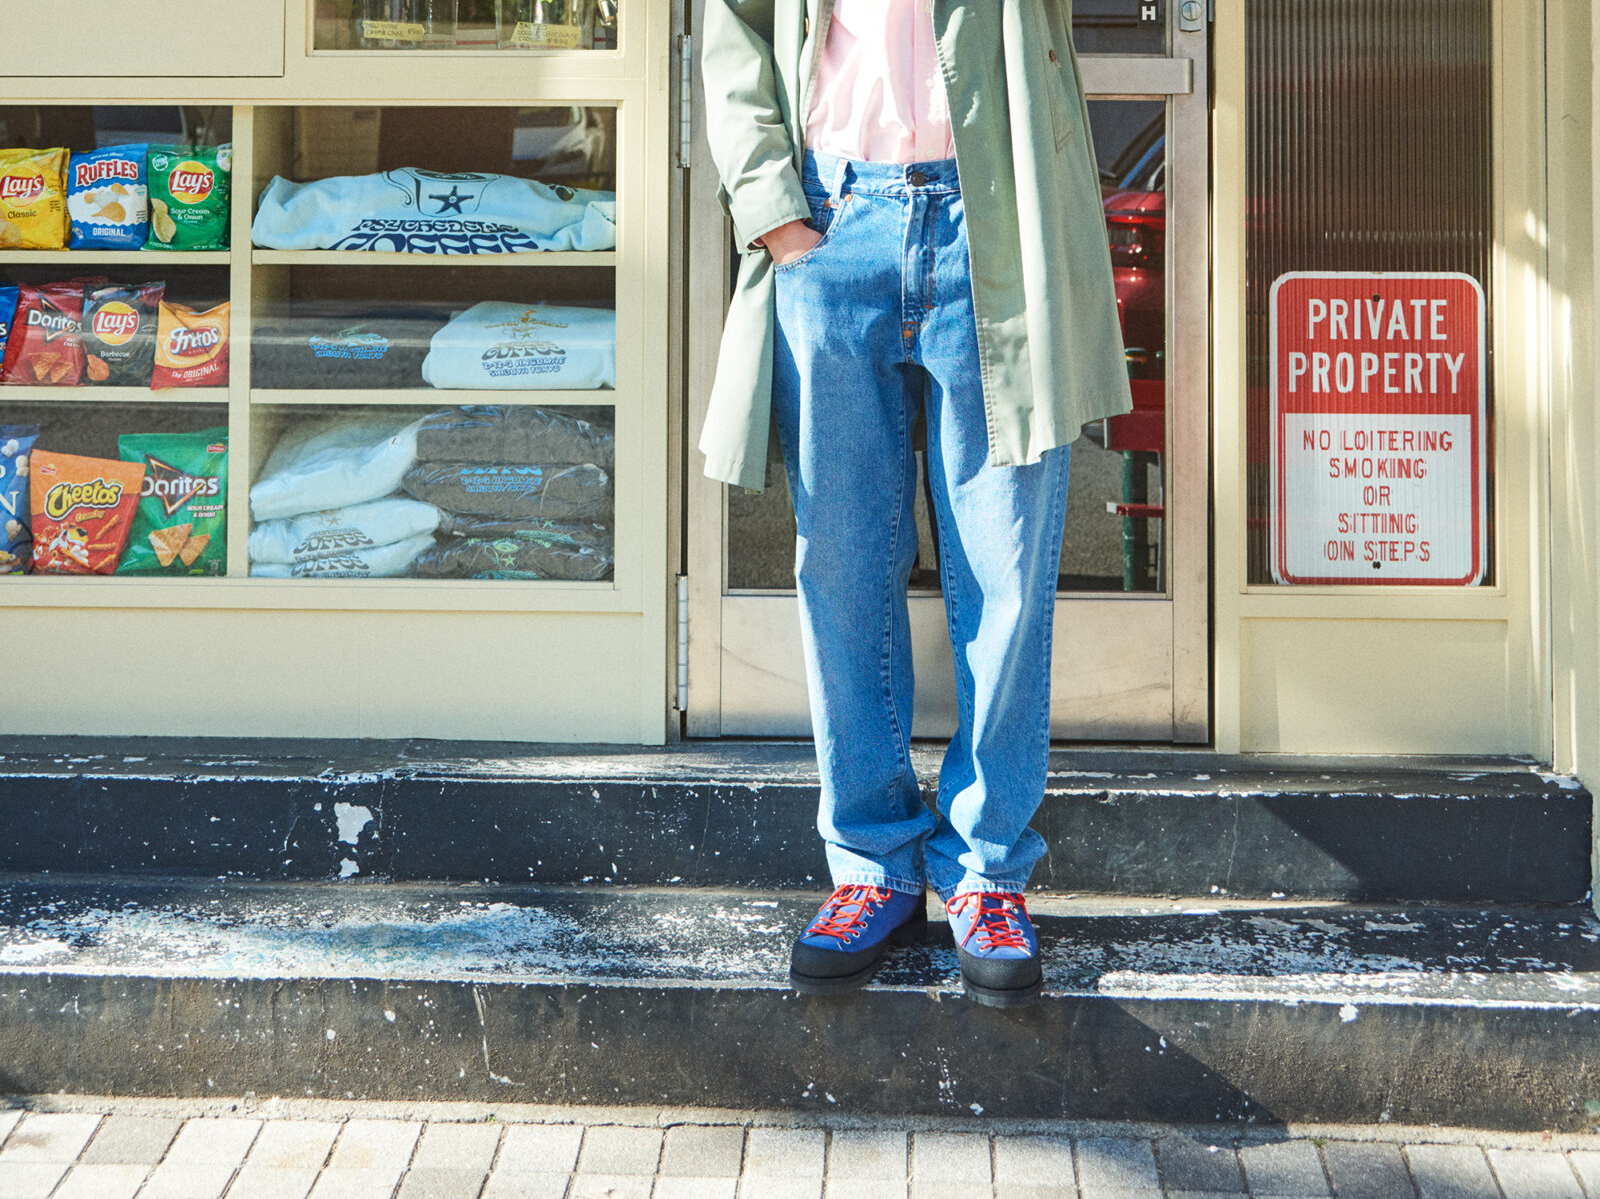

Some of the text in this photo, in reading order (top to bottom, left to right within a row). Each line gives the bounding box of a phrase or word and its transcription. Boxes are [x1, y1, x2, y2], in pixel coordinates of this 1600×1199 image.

[75, 159, 139, 188] RUFFLES
[171, 170, 213, 195] Lay's
[2, 175, 42, 200] Lay's
[7, 209, 38, 219] Classic
[92, 227, 126, 237] ORIGINAL
[27, 308, 82, 332] Doritos
[96, 312, 137, 336] Lay's
[1308, 299, 1448, 340] PRIVATE
[169, 326, 220, 355] Fritos
[183, 363, 220, 379] ORIGINAL
[1288, 352, 1465, 394] PROPERTY
[1303, 430, 1453, 451] NO LOITERING
[1329, 458, 1428, 479] SMOKING
[140, 475, 219, 498] Doritos
[1363, 486, 1392, 506] OR
[46, 478, 122, 519] Cheetos
[75, 509, 106, 522] Crunchy
[1338, 513, 1419, 534] SITTING
[293, 530, 374, 554] COFFEE
[1323, 540, 1431, 562] ON STEPS
